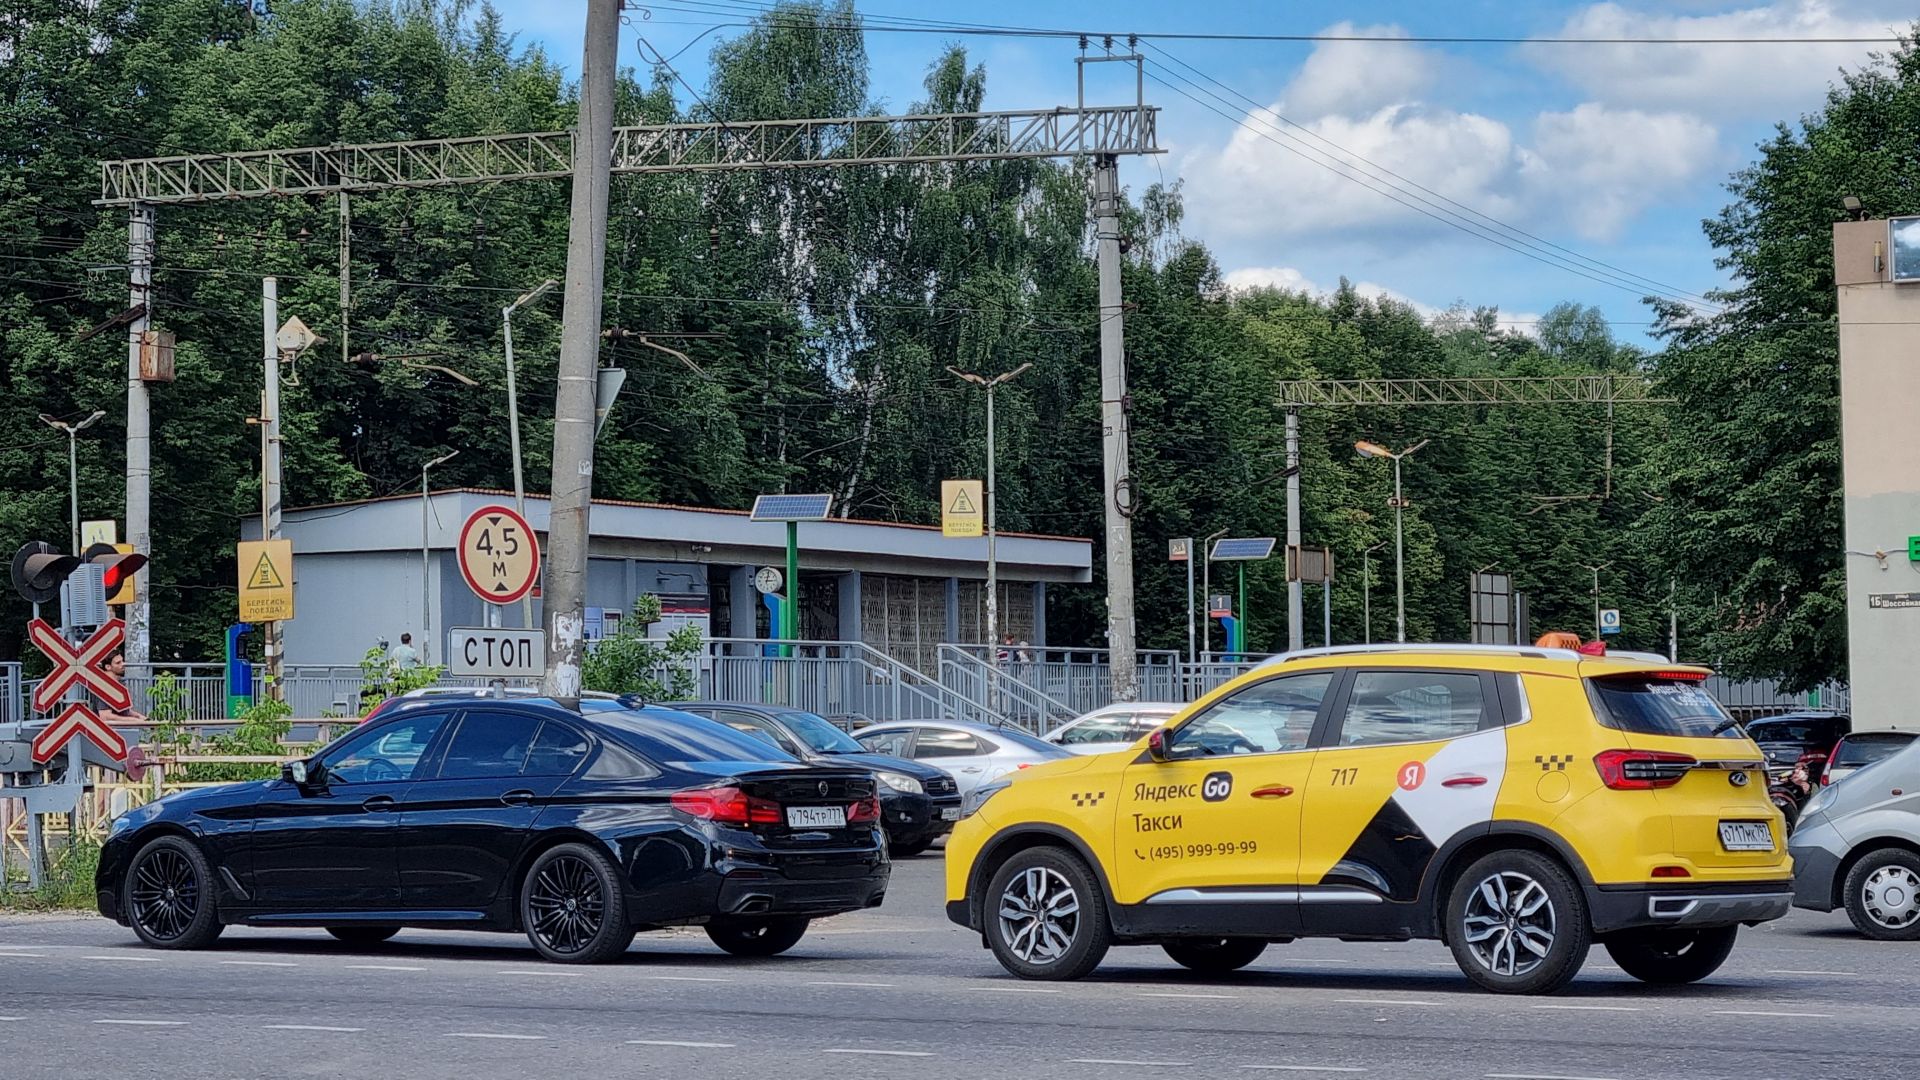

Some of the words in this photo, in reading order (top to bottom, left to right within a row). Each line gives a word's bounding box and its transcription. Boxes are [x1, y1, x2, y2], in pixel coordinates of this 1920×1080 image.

[476, 528, 518, 559] 4,5
[246, 599, 285, 607] БЕРЕГИСЬ
[1217, 597, 1223, 609] 1
[1882, 599, 1920, 608] Шоссейна
[464, 637, 531, 668] СТОП
[1331, 768, 1358, 786] 717
[1134, 783, 1197, 802] Яндекс
[1204, 777, 1230, 797] Go
[1132, 813, 1182, 832] Такси
[1149, 845, 1184, 861] (495)
[1187, 841, 1257, 857] 999-99-99
